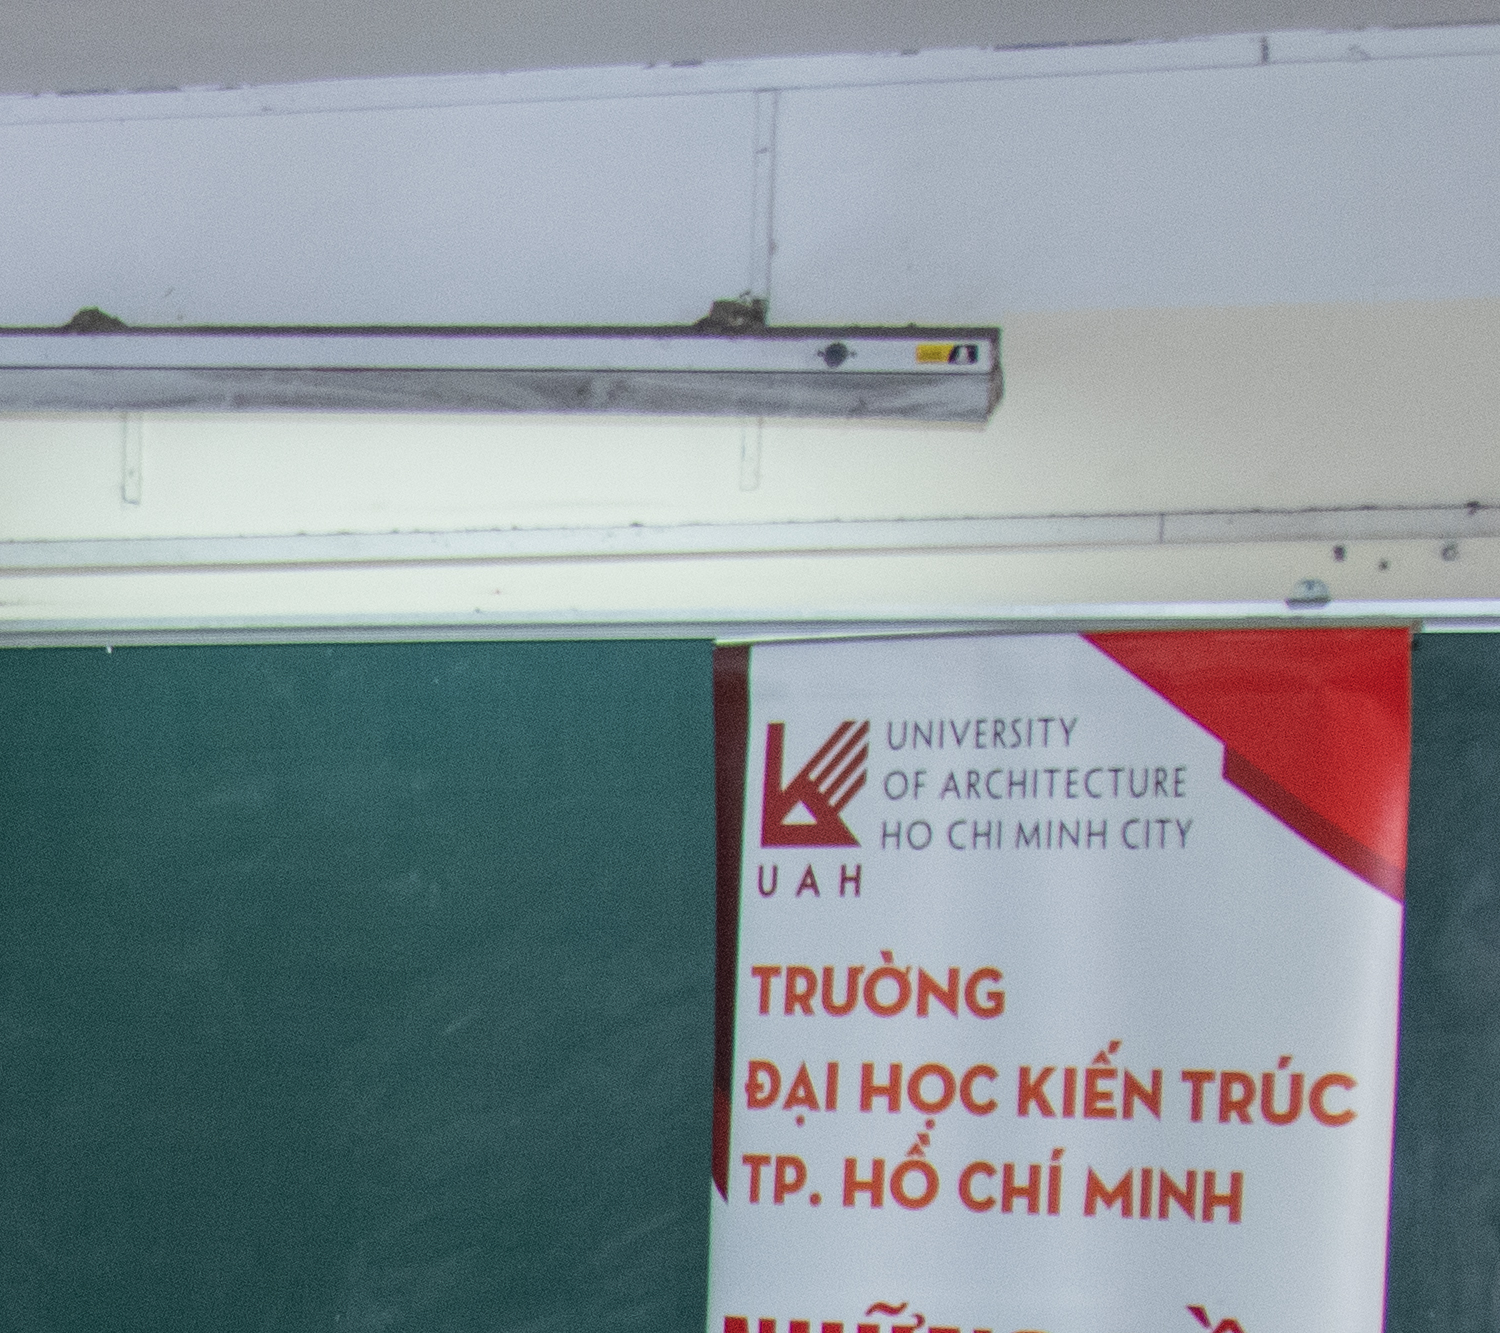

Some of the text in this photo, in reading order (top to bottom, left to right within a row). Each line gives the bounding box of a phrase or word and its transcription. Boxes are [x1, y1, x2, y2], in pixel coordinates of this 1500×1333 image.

[886, 717, 1078, 751] UNIVERSITY
[883, 766, 1187, 801] OF ARCHITECTURE
[880, 817, 1194, 851] HO CHI MINH CITY
[750, 949, 1006, 1020] TRƯỜNG
[745, 1039, 1359, 1131] ĐẠI HỌC KIẾN TRÚC
[741, 1131, 1245, 1225] TP. HỒ CHÍ MINH
